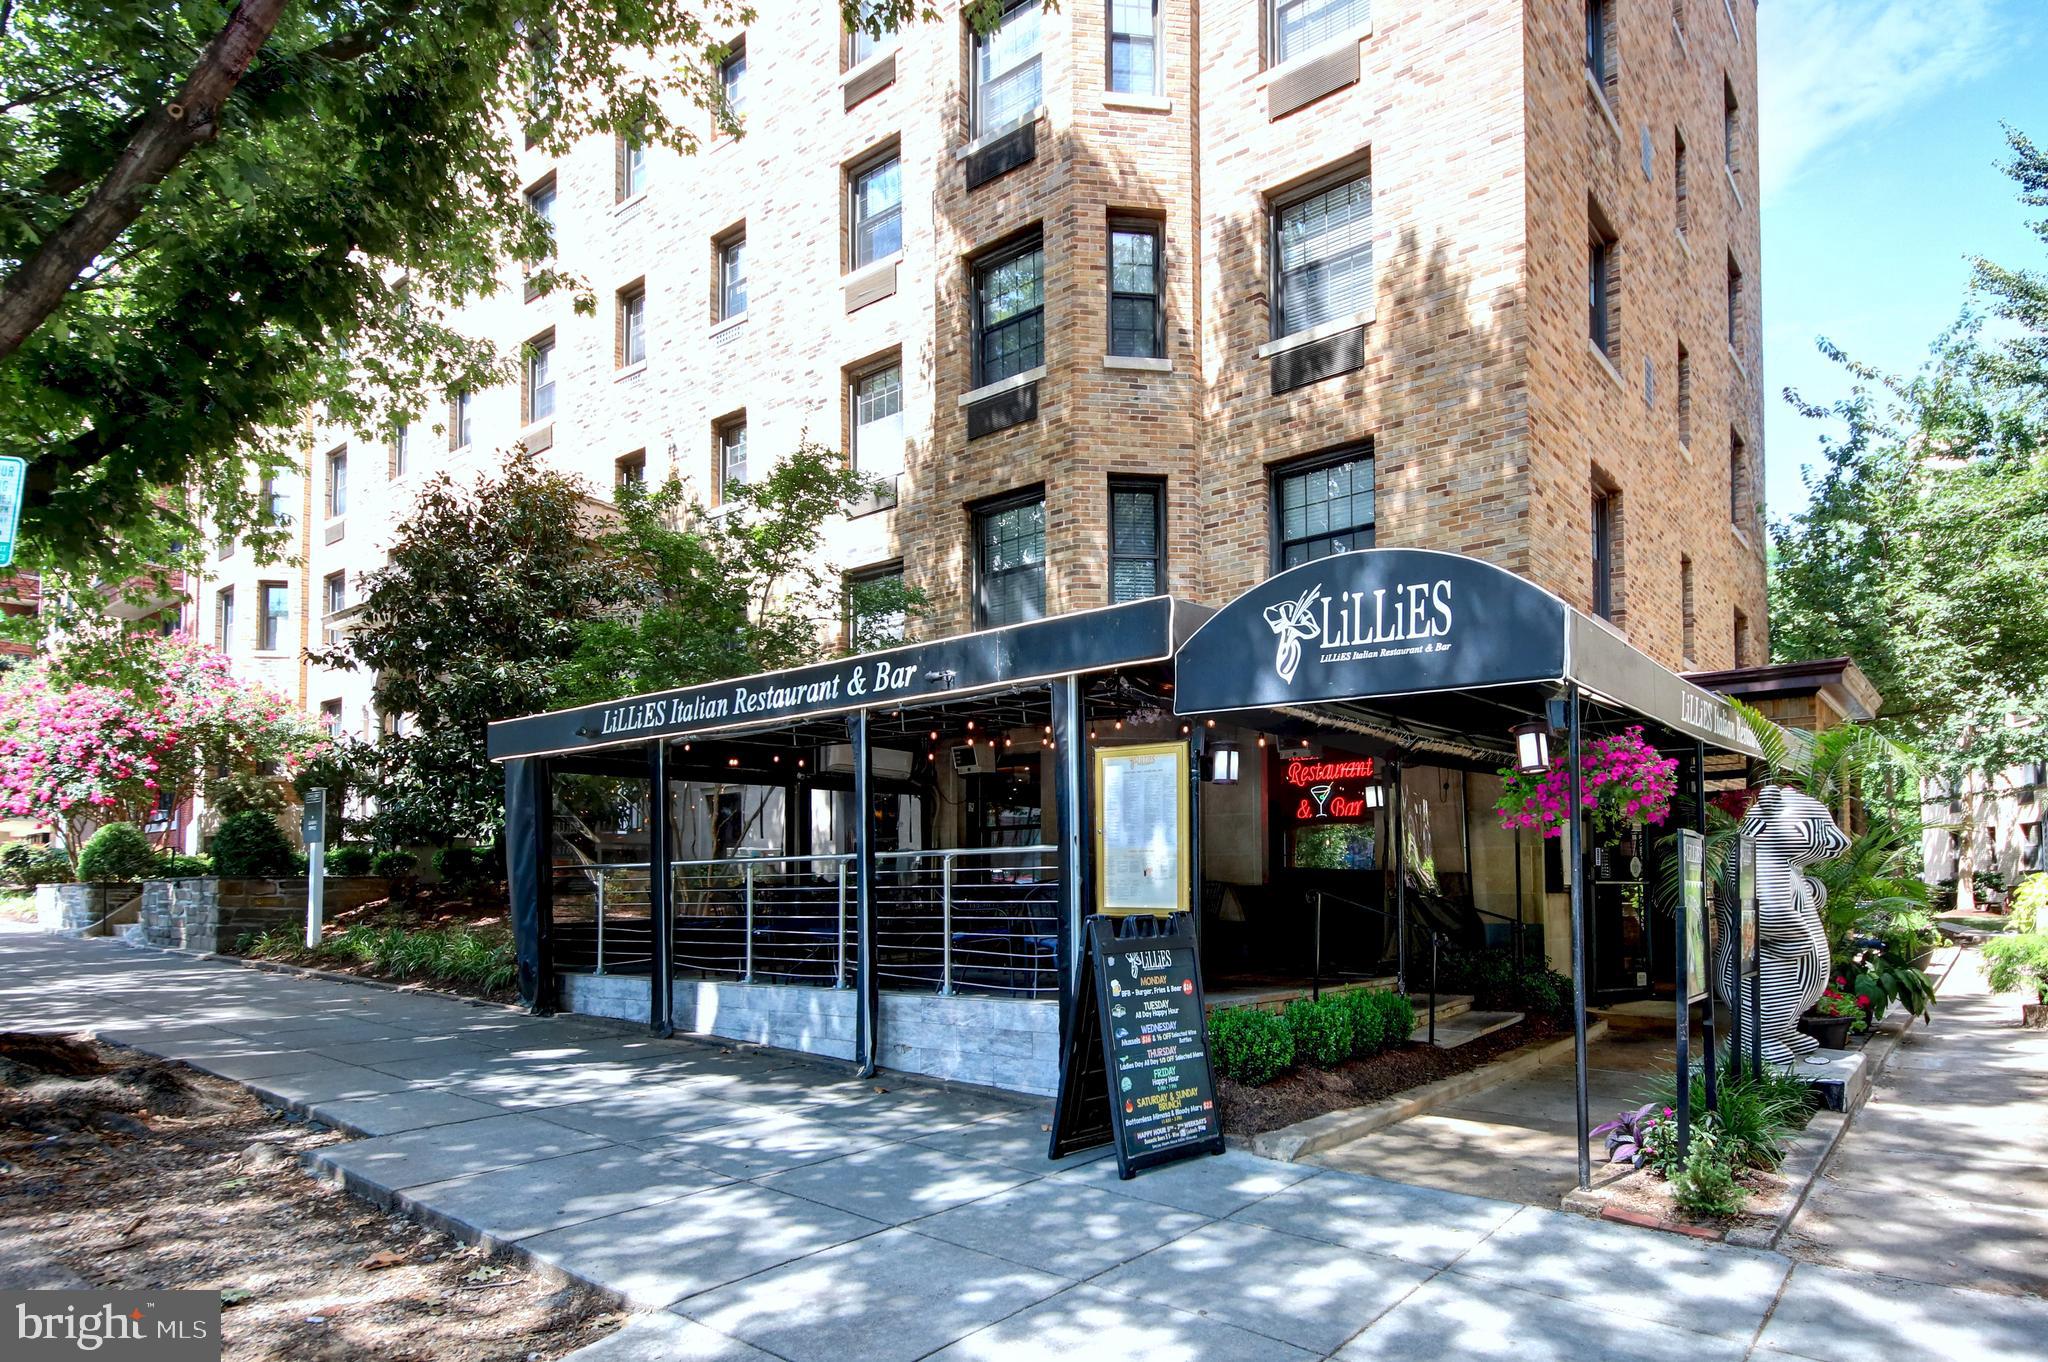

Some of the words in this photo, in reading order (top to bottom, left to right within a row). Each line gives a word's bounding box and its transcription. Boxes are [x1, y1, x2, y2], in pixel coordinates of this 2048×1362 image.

[1352, 650, 1379, 660] Italian
[1379, 645, 1423, 657] Restaurant
[1425, 645, 1433, 653] &
[1435, 642, 1451, 652] Bar
[668, 698, 728, 725] Italian
[732, 674, 839, 716] Restaurant
[846, 665, 867, 696] &
[873, 661, 917, 692] Bar
[1288, 757, 1374, 786] Restaurant
[1297, 799, 1312, 819] &
[1330, 797, 1364, 817] Bar
[1140, 975, 1167, 986] MONDAY
[1144, 1000, 1169, 1010] TUESDAY
[1152, 1009, 1168, 1017] Happy
[1141, 1021, 1177, 1034] WEDNESDAY
[1147, 1046, 1177, 1059] THURSDAY
[1120, 1062, 1134, 1070] Ladies
[1175, 1053, 1192, 1061] Selected
[1153, 1066, 1176, 1079] FRIDAY
[1152, 1077, 1168, 1086] Happy
[1168, 1075, 1180, 1083] Hour
[1136, 1093, 1168, 1108] SATURDAY
[1169, 1091, 1175, 1100] &
[1176, 1087, 1198, 1099] SUNDAY
[1158, 1100, 1182, 1112] BRUNCH
[1125, 1115, 1152, 1127] Bottomless
[1152, 1111, 1171, 1121] Mimosa
[1175, 1107, 1190, 1116] Bloody
[1190, 1104, 1202, 1112] Mary
[1137, 1130, 1152, 1139] HAPPY
[1153, 1127, 1166, 1136] HOUR
